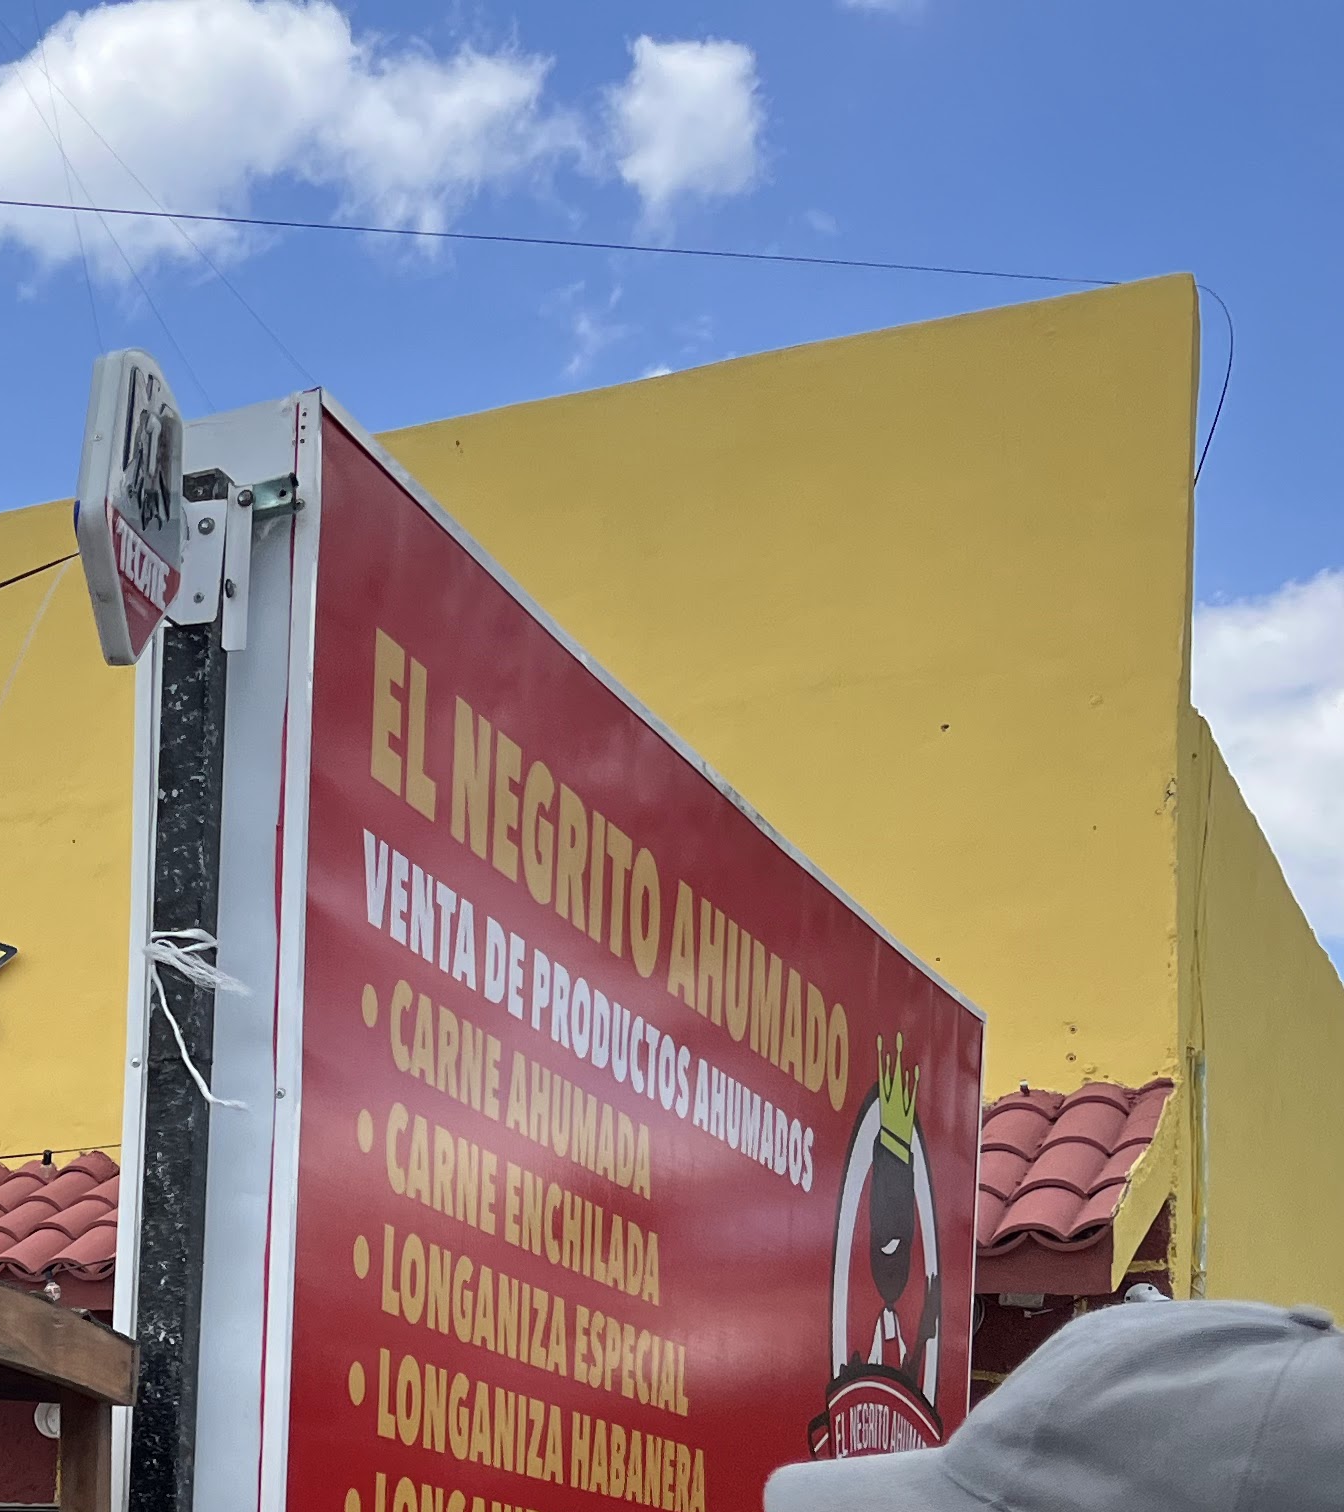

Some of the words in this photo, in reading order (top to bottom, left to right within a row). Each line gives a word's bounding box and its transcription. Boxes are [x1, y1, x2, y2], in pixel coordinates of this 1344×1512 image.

[115, 514, 170, 613] TECATE
[370, 627, 436, 822] EL
[450, 695, 661, 979] NEGRITO
[667, 880, 849, 1112] AHUMADO
[362, 827, 477, 991] VENTA
[484, 916, 525, 1020] DE
[531, 949, 691, 1120] PRODUCTOS
[693, 1058, 815, 1193] AHUMADOS
[390, 979, 502, 1122] CARNE
[506, 1051, 652, 1200] AHUMADA
[385, 1102, 498, 1235] CARNE
[504, 1160, 661, 1307] ENCHILADA
[376, 1347, 564, 1485] LONGANIZA
[381, 1223, 568, 1378] LONGANIZA
[573, 1305, 690, 1417] ESPECIAL
[835, 1411, 848, 1459] EL
[849, 1402, 889, 1453] NEGRITO
